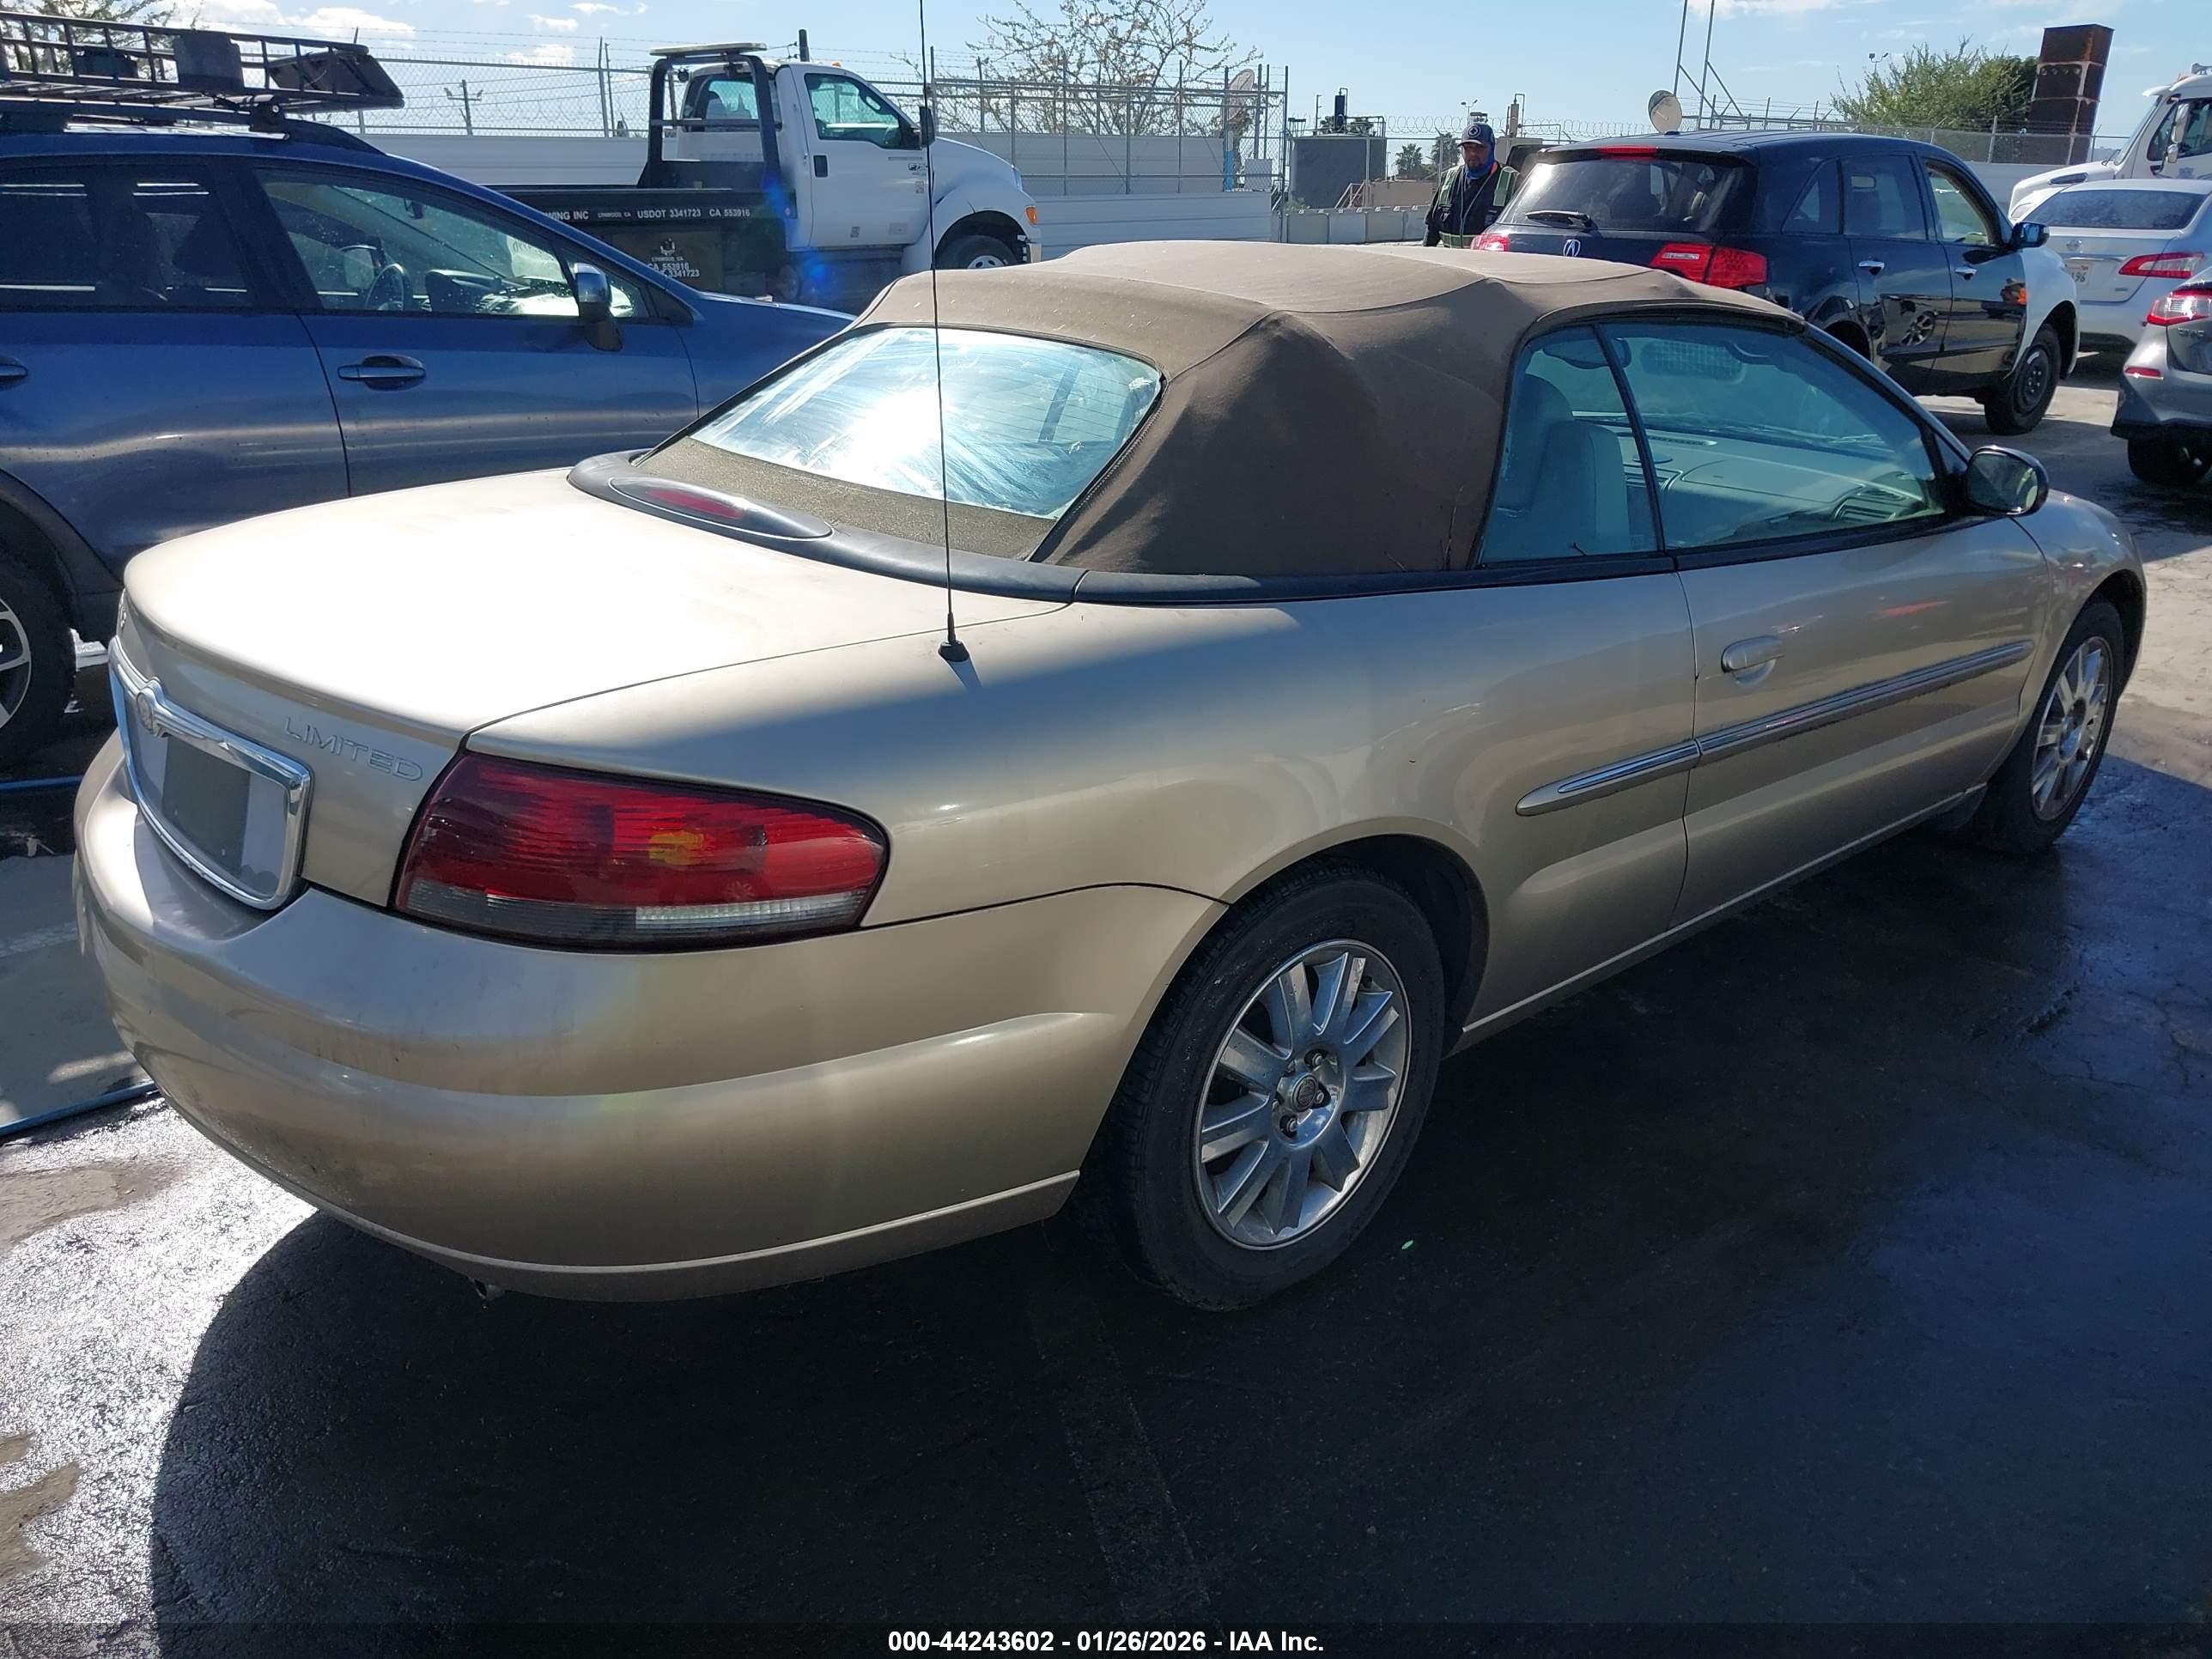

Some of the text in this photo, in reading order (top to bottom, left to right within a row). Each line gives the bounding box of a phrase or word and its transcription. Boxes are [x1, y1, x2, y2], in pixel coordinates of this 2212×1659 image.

[574, 210, 589, 220] INC
[636, 209, 666, 219] USDOT
[669, 208, 702, 218] 3341723
[708, 208, 721, 217] CA
[724, 208, 750, 217] 553916
[285, 717, 423, 781] LIMITED
